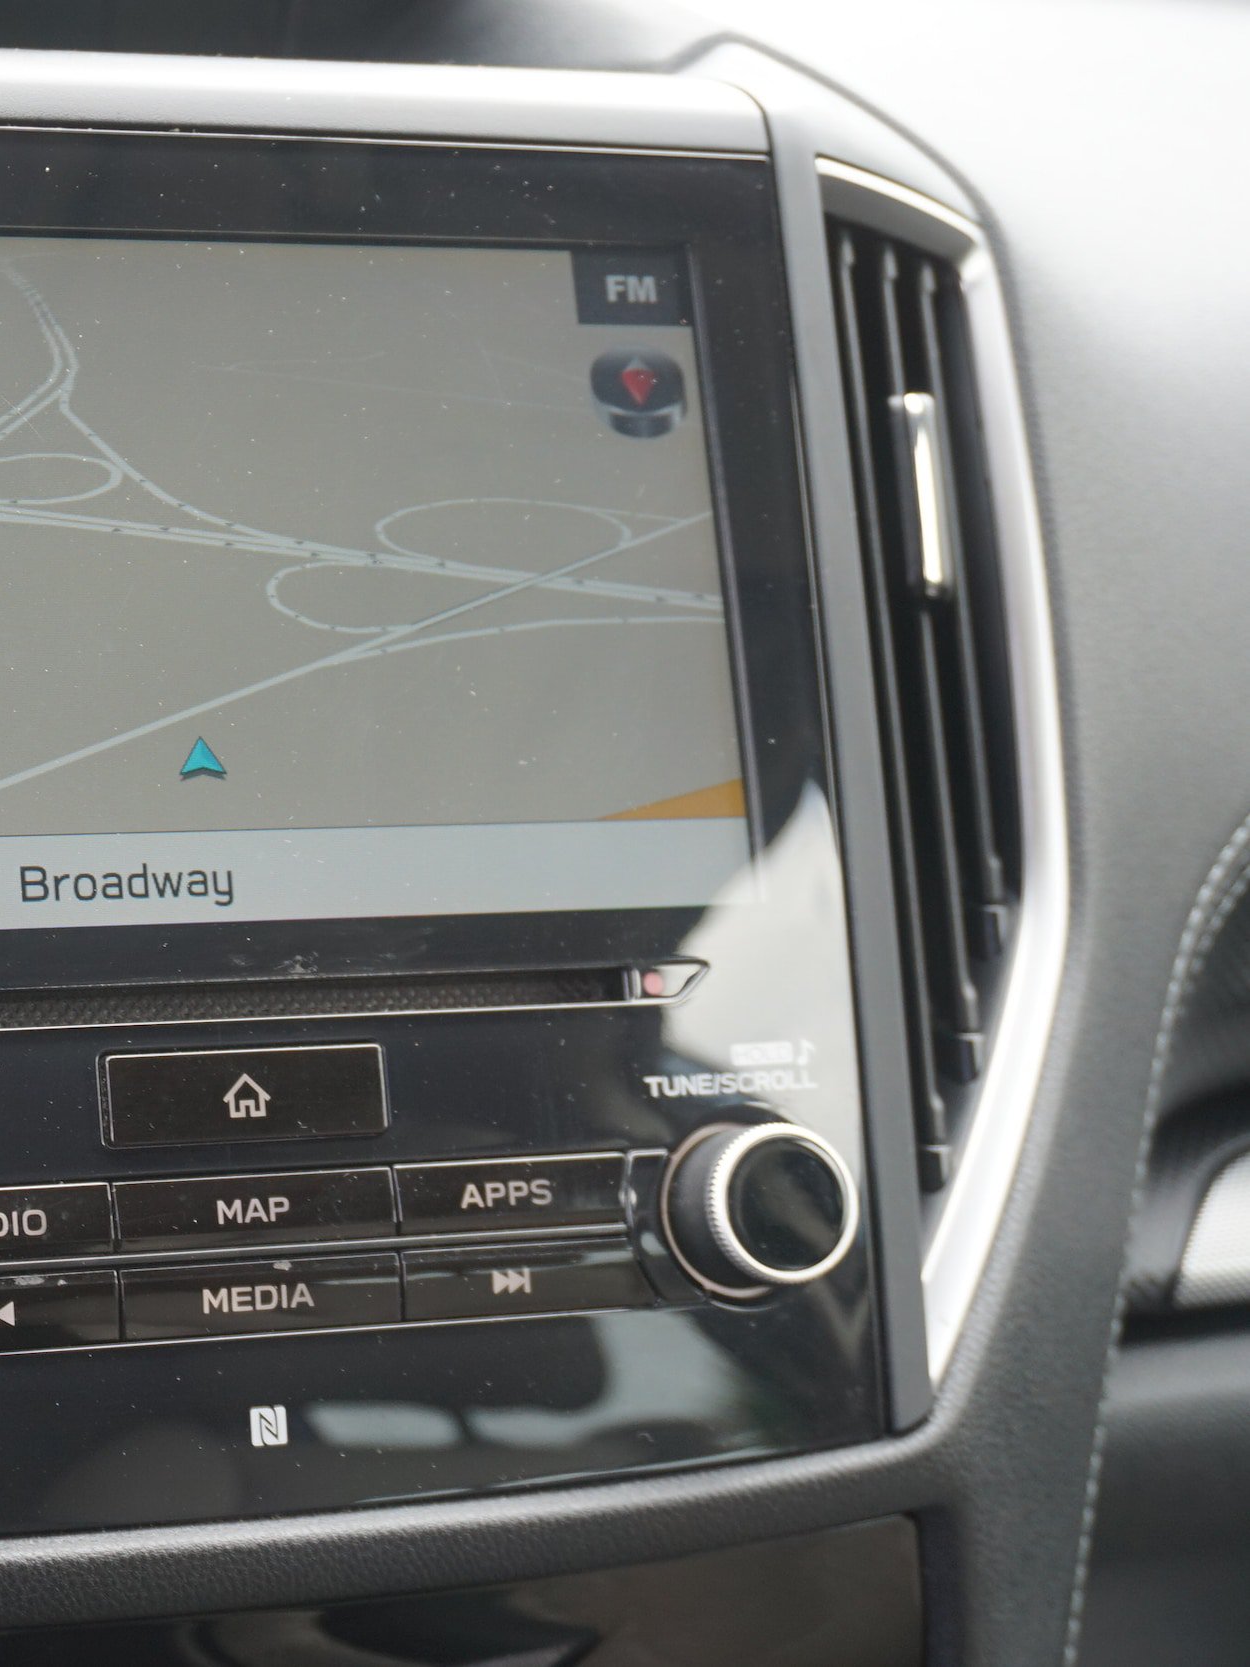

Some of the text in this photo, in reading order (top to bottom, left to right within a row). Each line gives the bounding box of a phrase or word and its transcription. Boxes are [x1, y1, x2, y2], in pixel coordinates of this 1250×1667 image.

[605, 274, 657, 304] FM
[20, 863, 234, 907] Broadway
[643, 1069, 818, 1099] TUNE/SCROLL
[461, 1179, 553, 1209] APPS
[216, 1197, 291, 1225] MAP
[202, 1283, 315, 1314] MEDIA
